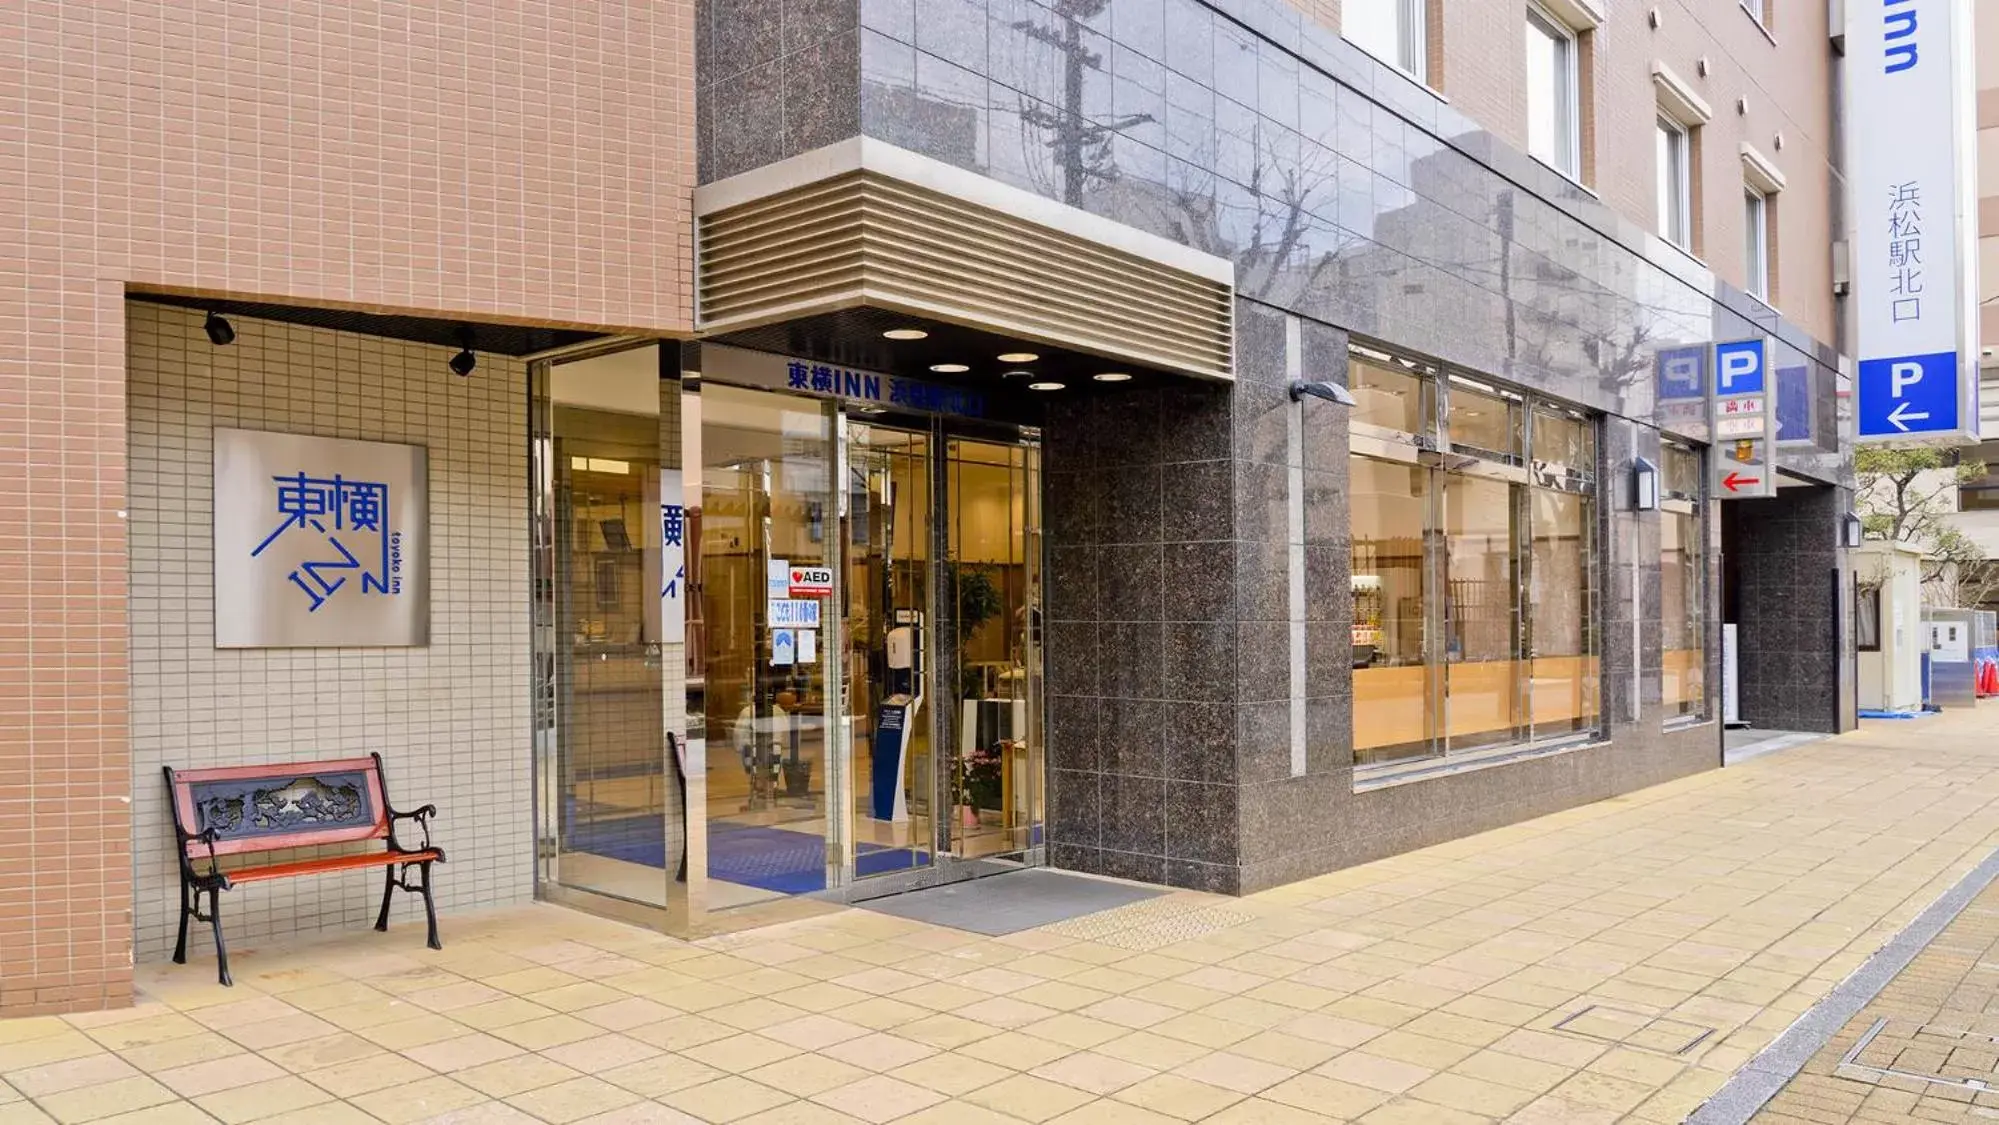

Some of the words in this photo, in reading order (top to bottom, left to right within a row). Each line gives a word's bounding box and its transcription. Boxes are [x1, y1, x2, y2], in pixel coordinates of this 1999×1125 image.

[1888, 181, 1922, 324] 浜松駅北口
[787, 362, 880, 401] 東横INN
[1721, 350, 1758, 387] P
[1891, 361, 1924, 399] P
[391, 532, 402, 573] toyoko
[391, 576, 401, 594] inn
[803, 571, 830, 583] AED
